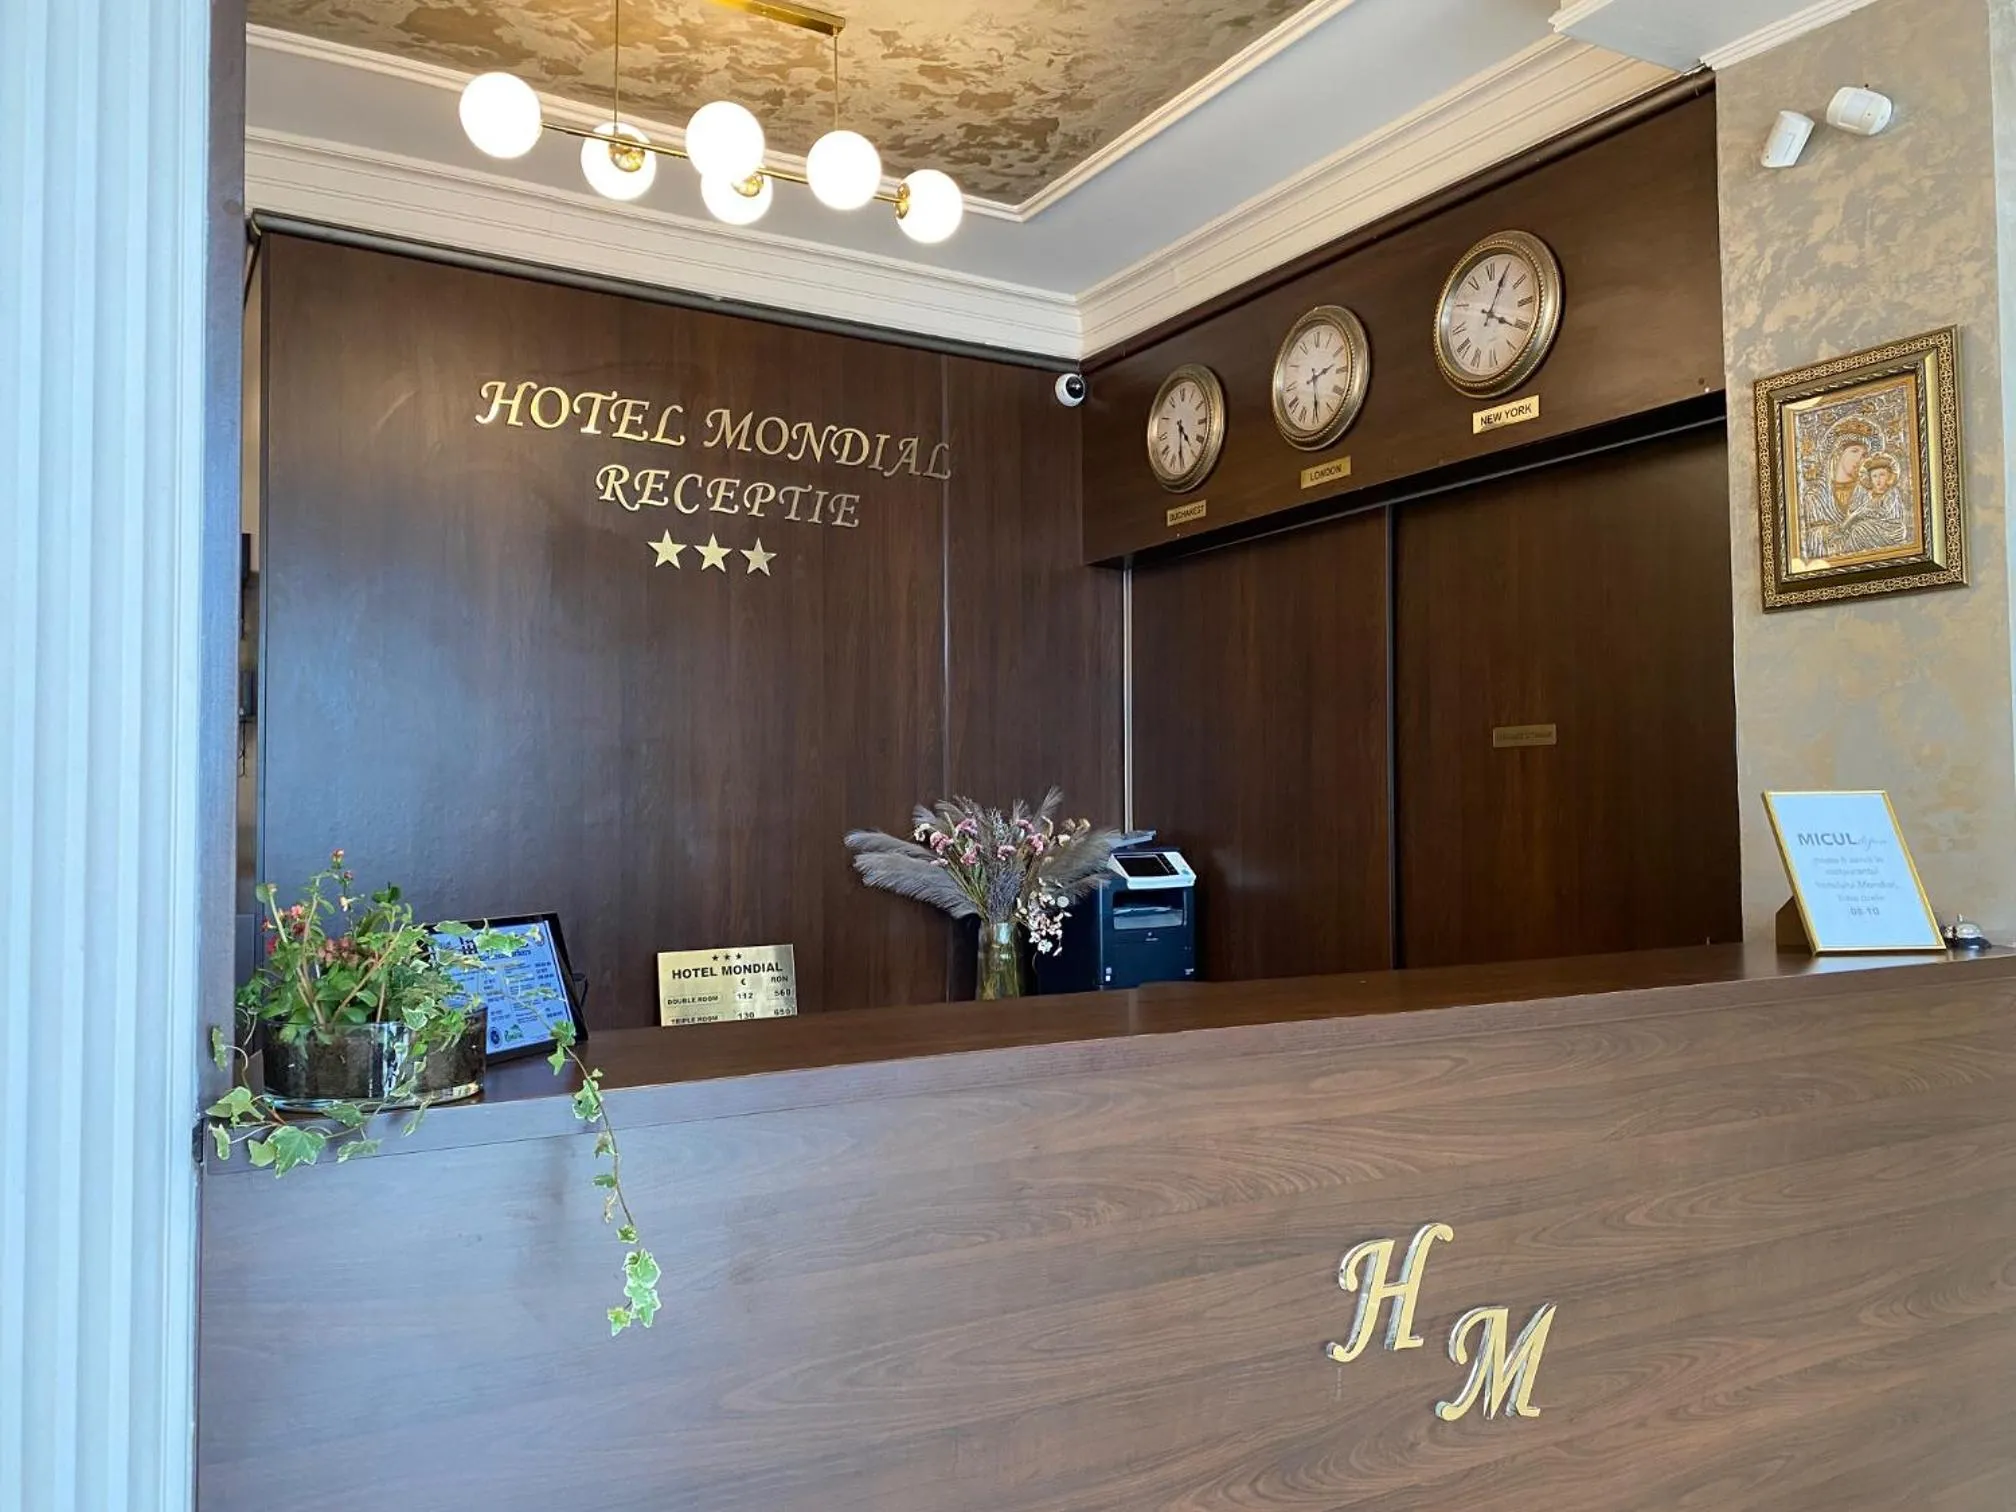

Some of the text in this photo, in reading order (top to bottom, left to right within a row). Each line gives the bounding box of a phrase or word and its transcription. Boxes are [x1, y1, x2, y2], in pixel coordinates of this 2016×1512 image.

[1480, 403, 1532, 426] NEW YORK
[475, 381, 952, 481] HOTEL MONDIAL
[1310, 463, 1342, 481] LONDON
[595, 464, 861, 528] RECEPTIE
[1797, 832, 1857, 847] MICUL
[671, 962, 782, 979] HOTEL MONDIAL
[667, 997, 696, 1006] DOUBLE
[1326, 1222, 1454, 1363] H
[1435, 1302, 1558, 1421] M
